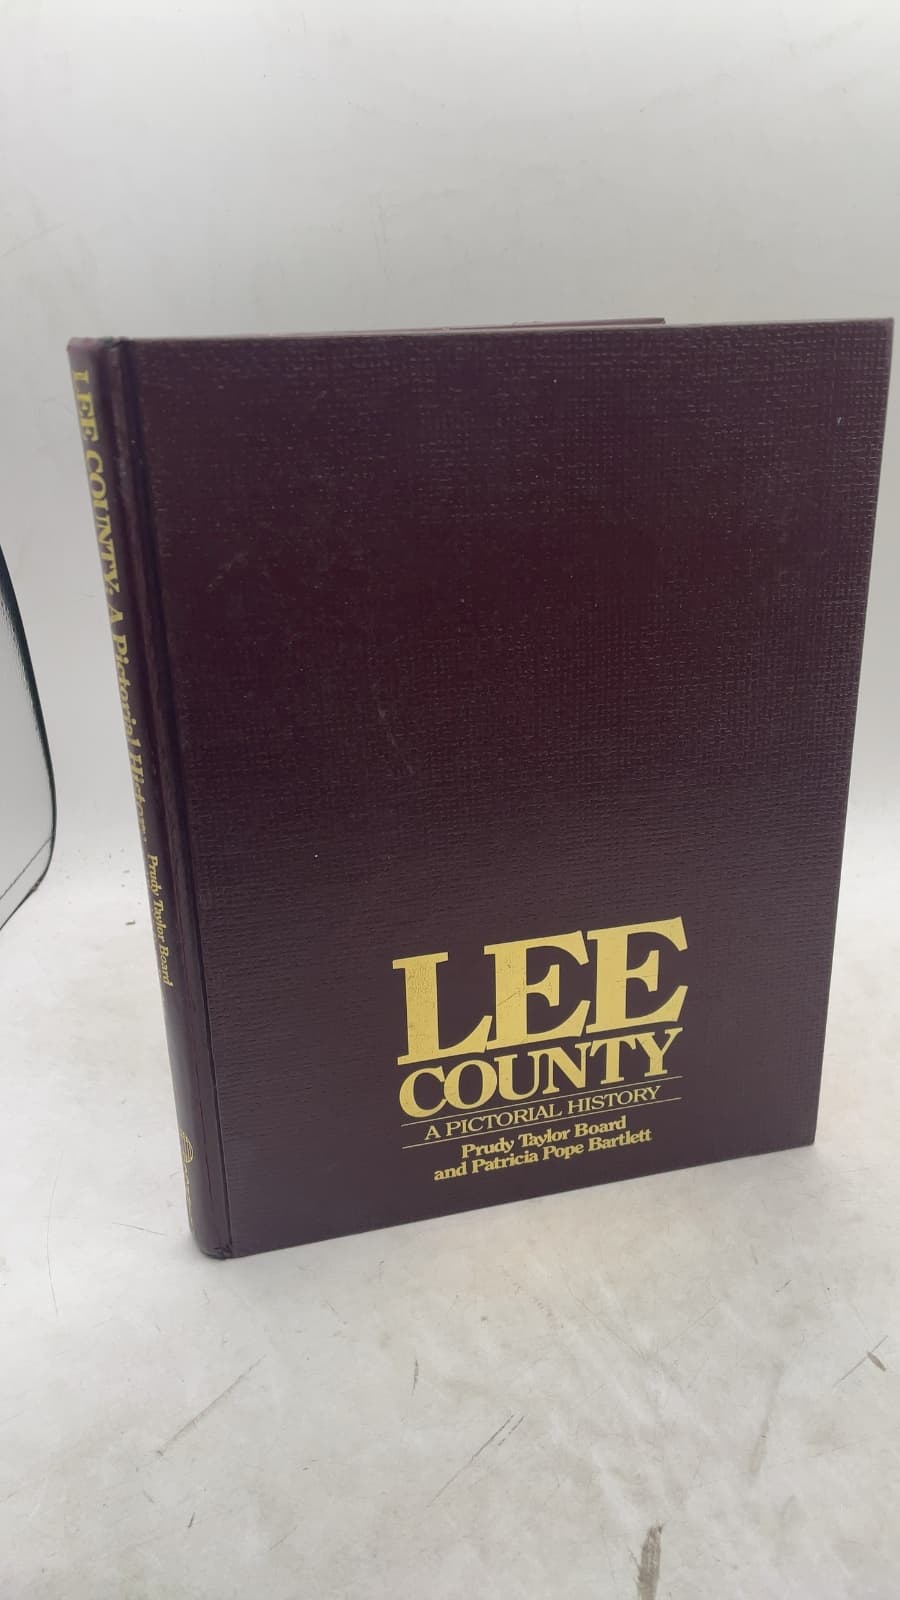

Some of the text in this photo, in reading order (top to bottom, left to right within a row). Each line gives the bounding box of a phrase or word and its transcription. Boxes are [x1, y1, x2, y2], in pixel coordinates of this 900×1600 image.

[73, 369, 98, 442] LEE
[108, 605, 123, 624] A
[112, 634, 142, 748] Pictorial
[147, 855, 174, 987] Prudy Taylor Board
[392, 916, 688, 1065] LEE
[399, 1027, 683, 1118] COUNTY
[424, 1086, 662, 1140] A PICTORIAL HISTORY
[461, 1116, 626, 1158] Prudy Taylor Board
[434, 1129, 652, 1181] and Patricia Pope Bartlett
